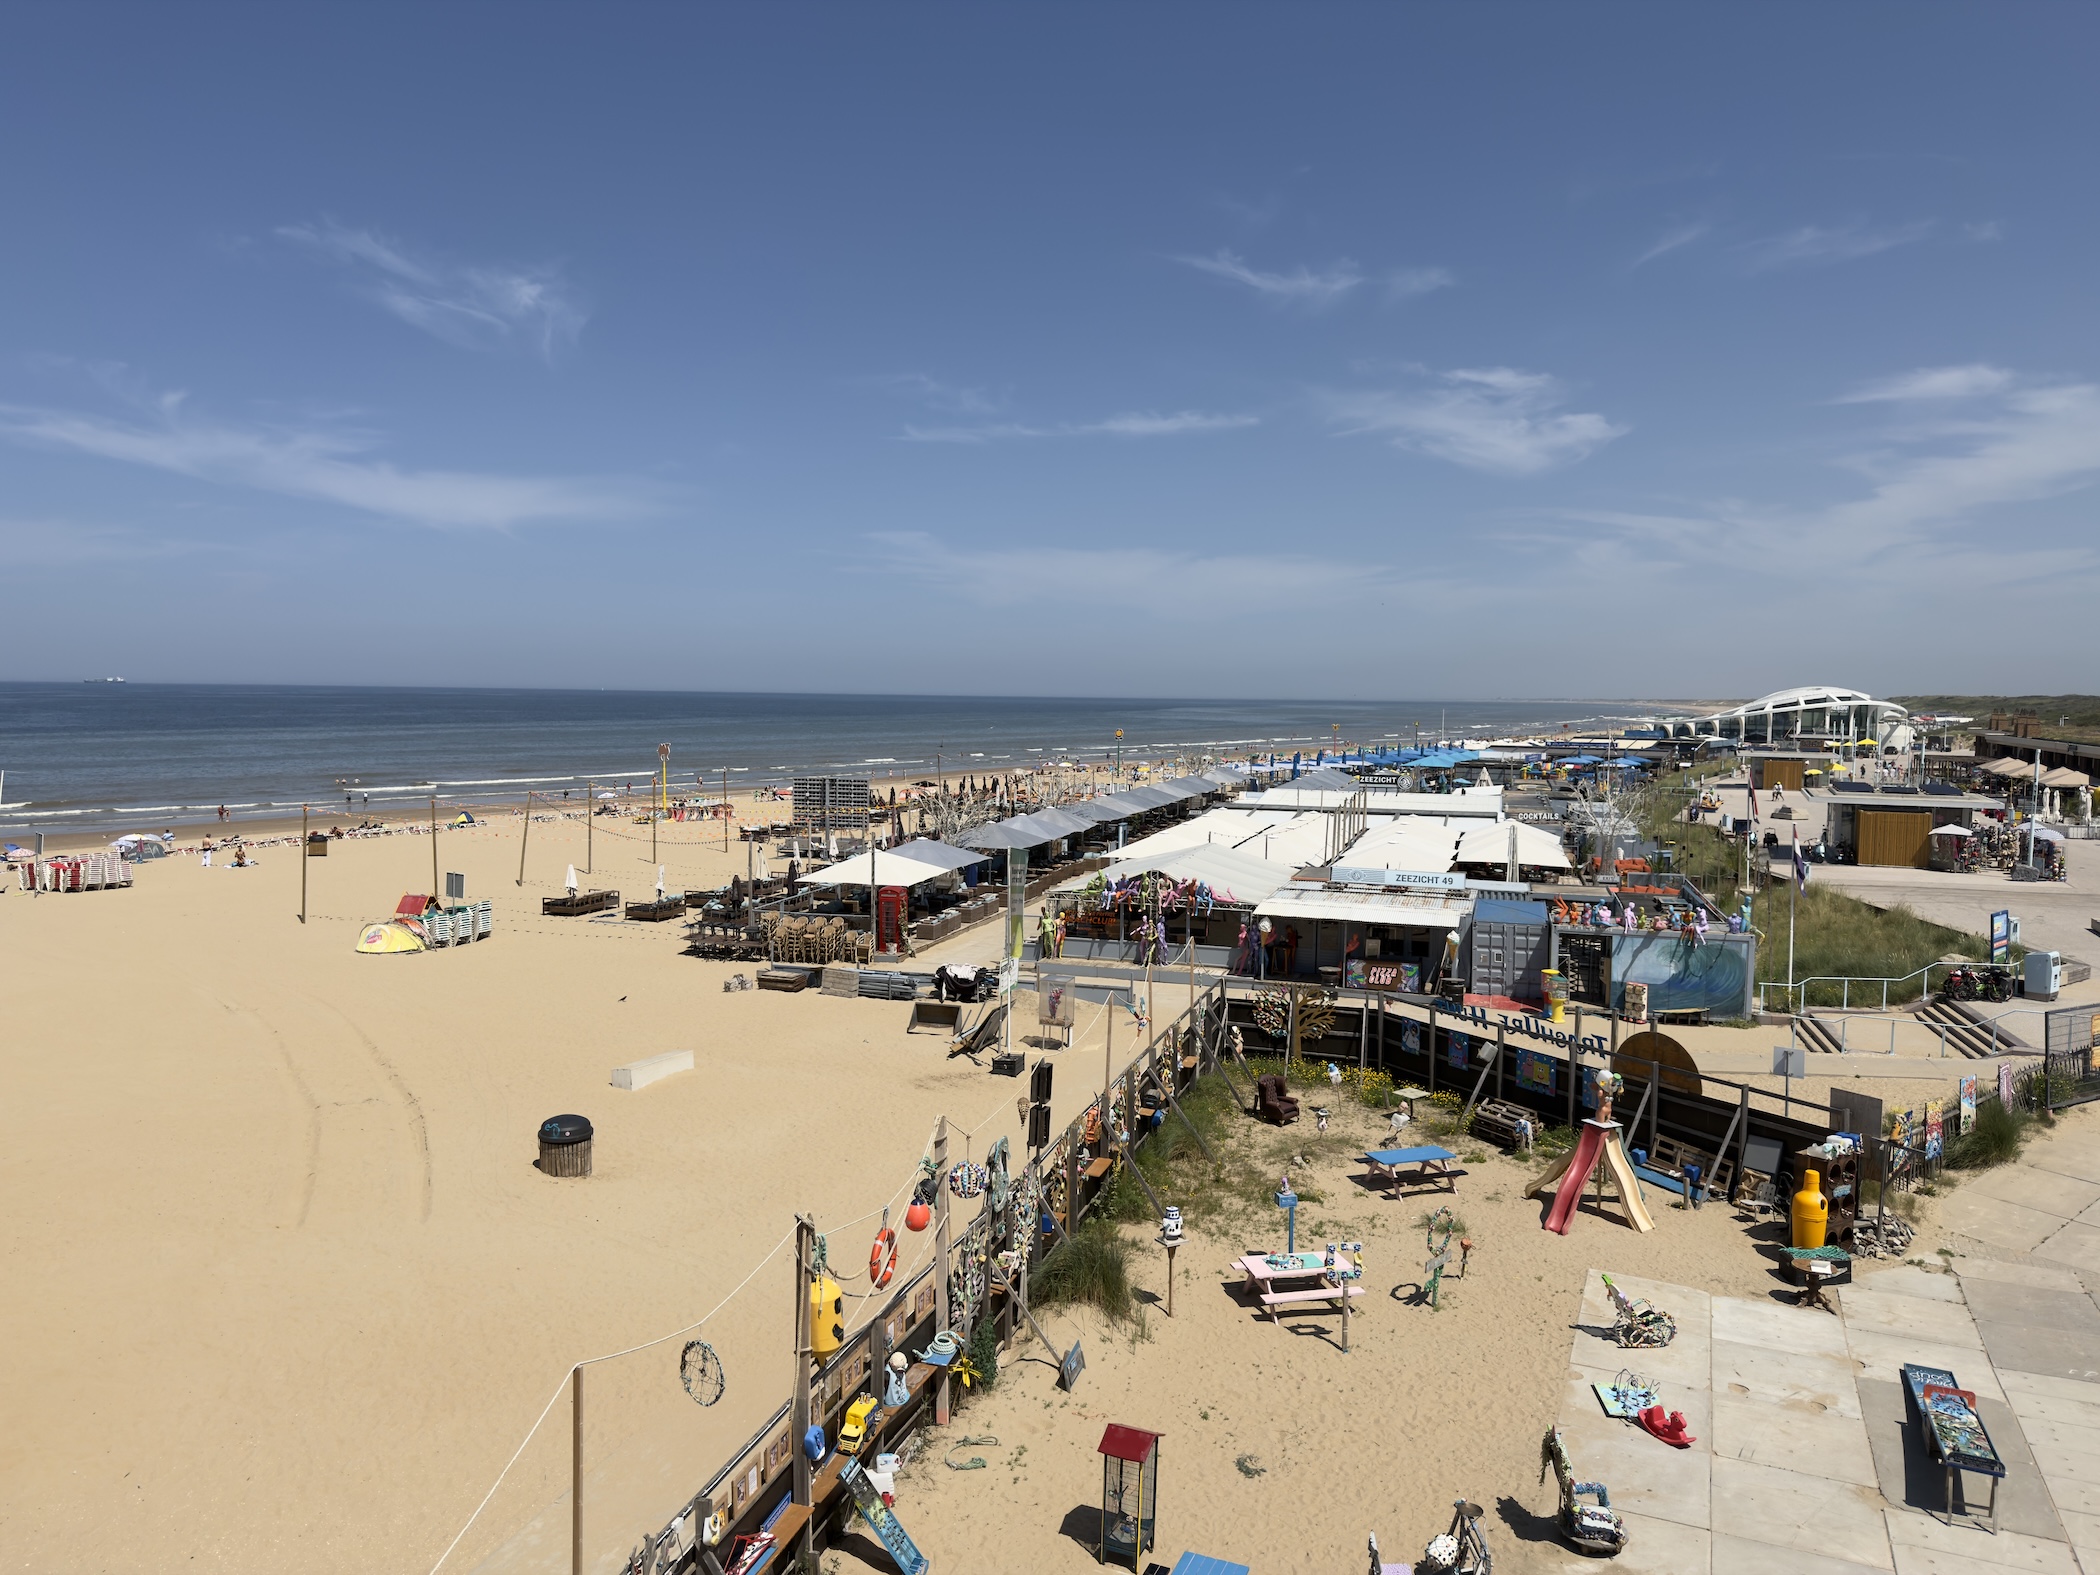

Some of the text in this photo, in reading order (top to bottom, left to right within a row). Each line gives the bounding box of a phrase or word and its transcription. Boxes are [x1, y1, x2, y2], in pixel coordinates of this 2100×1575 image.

[1518, 812, 1559, 820] COCKTAILS
[1395, 874, 1454, 885] ZEEZICHT 49
[1370, 966, 1398, 977] PIZZA
[1368, 974, 1392, 985] CLUB
